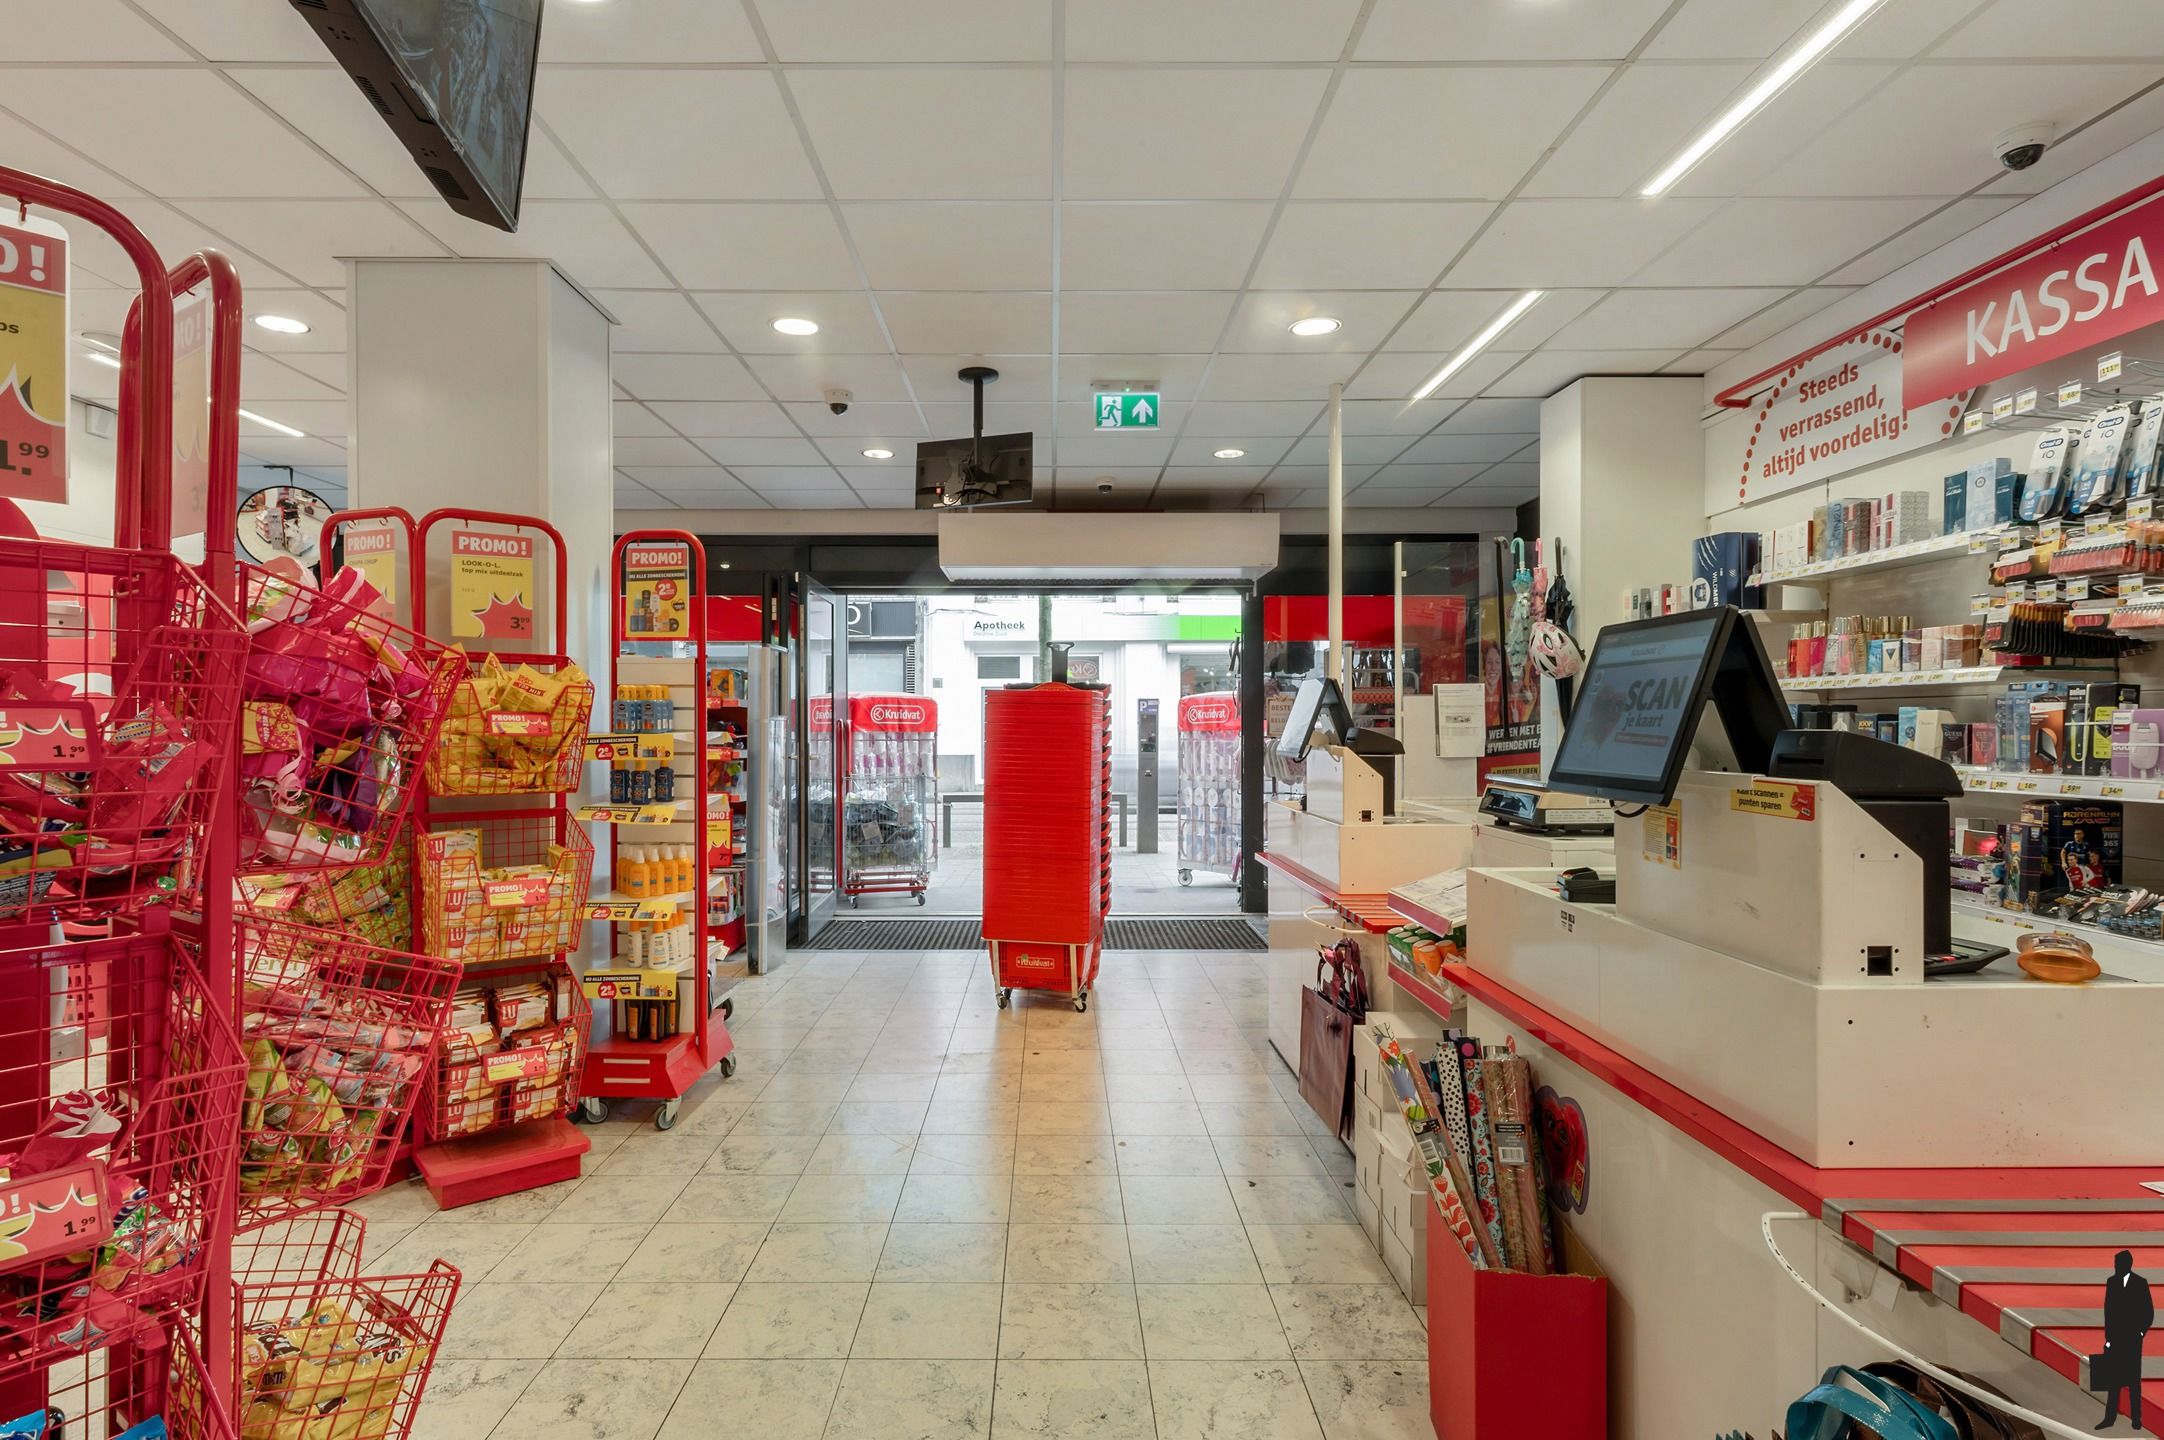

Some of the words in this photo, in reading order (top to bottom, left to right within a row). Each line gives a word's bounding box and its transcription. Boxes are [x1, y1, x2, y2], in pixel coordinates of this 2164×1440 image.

[1967, 236, 2159, 365] KASSA
[1800, 362, 1859, 403] Steeds
[1779, 384, 1884, 442] verrassend,
[1763, 445, 1805, 478] altijd
[1809, 408, 1908, 461] voordelig!
[458, 535, 527, 555] PROMO!
[631, 552, 682, 564] PROMO!
[974, 621, 1025, 632] Apotheek
[1624, 676, 1688, 712] SCAN
[1139, 700, 1147, 711] P
[885, 709, 920, 720] Kruidvat
[1197, 709, 1226, 719] Kruidvat
[1623, 715, 1635, 730] je
[1635, 713, 1663, 728] kaart
[1489, 728, 1517, 740] WEREN
[1520, 725, 1534, 735] MET
[53, 744, 85, 758] 1.99
[1753, 789, 1779, 798] scannen
[1738, 799, 1759, 807] punten
[1761, 801, 1781, 810] sparen
[489, 884, 523, 893] PROMO!
[450, 928, 463, 941] LU
[508, 923, 521, 934] LU
[502, 1005, 516, 1020] LU
[487, 1054, 522, 1065] PROMO!
[517, 1092, 530, 1104] LU
[448, 1104, 462, 1116] LU
[64, 1216, 96, 1237] 1.99
